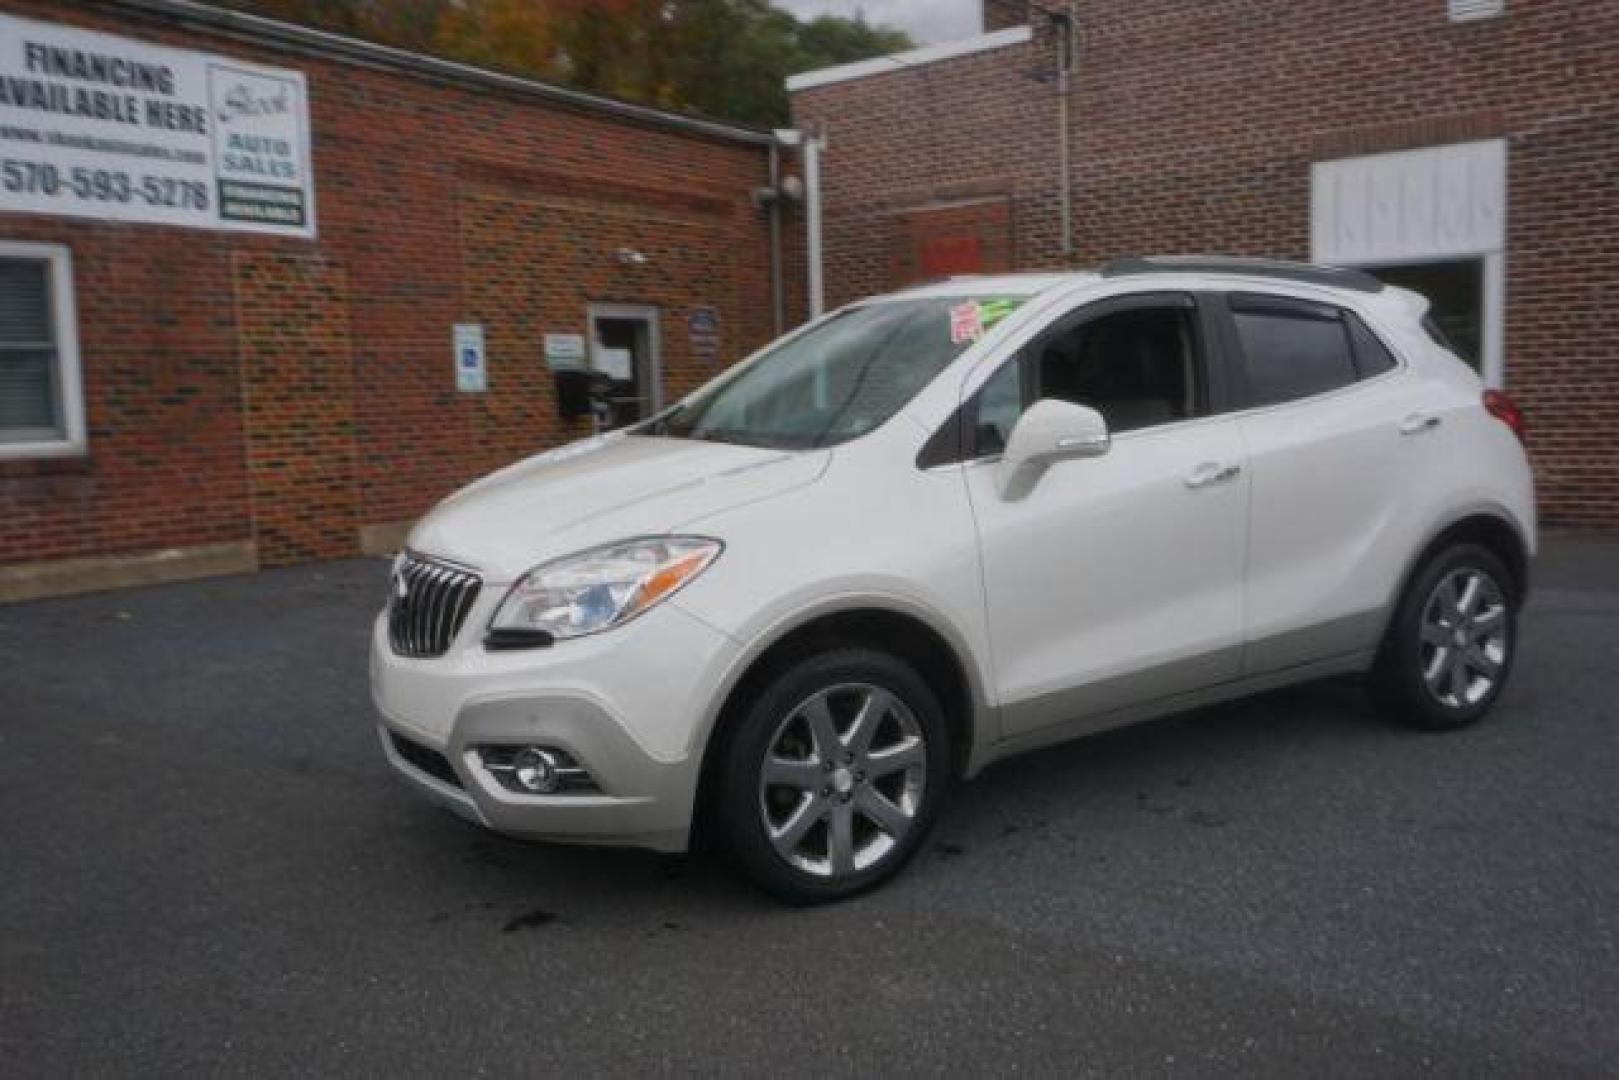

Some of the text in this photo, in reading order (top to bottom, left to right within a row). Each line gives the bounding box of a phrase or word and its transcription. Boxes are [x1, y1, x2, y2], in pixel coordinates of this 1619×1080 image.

[24, 40, 174, 96] FINANCING
[145, 99, 207, 135] HERE
[226, 133, 290, 157] AUTO
[222, 153, 295, 178] SALES
